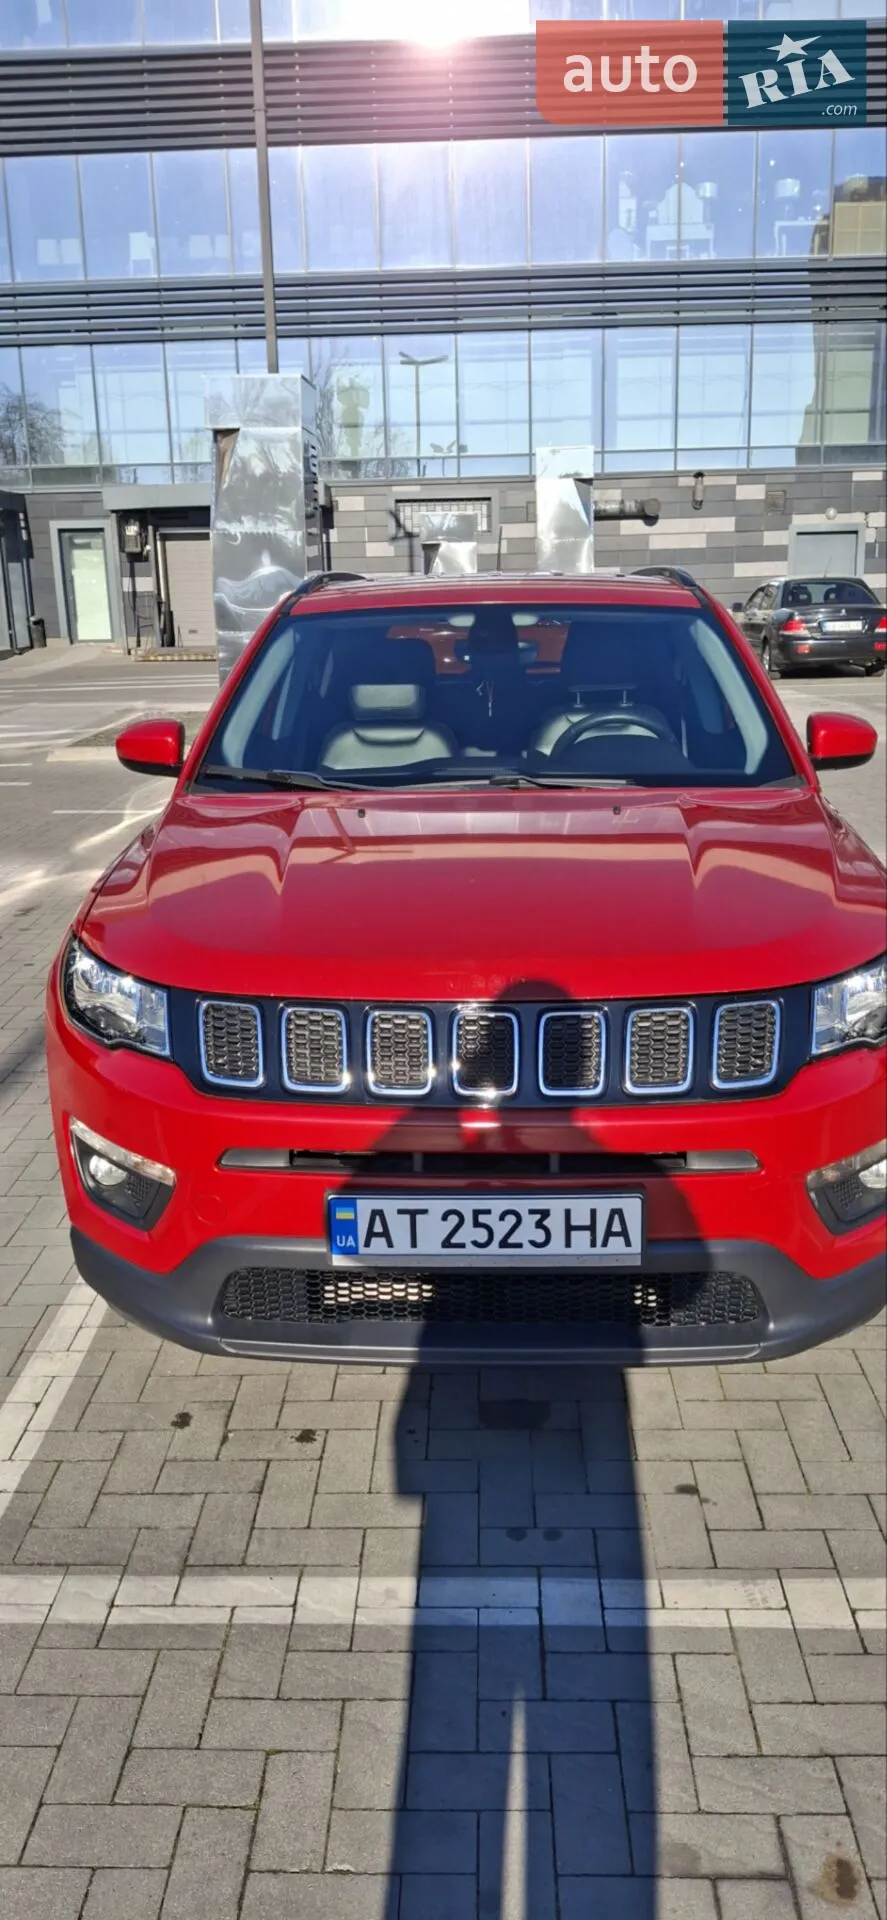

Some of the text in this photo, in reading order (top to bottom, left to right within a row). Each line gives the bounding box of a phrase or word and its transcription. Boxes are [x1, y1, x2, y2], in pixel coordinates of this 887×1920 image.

[336, 1234, 356, 1248] UA
[363, 1208, 632, 1249] AT 2523 HA
